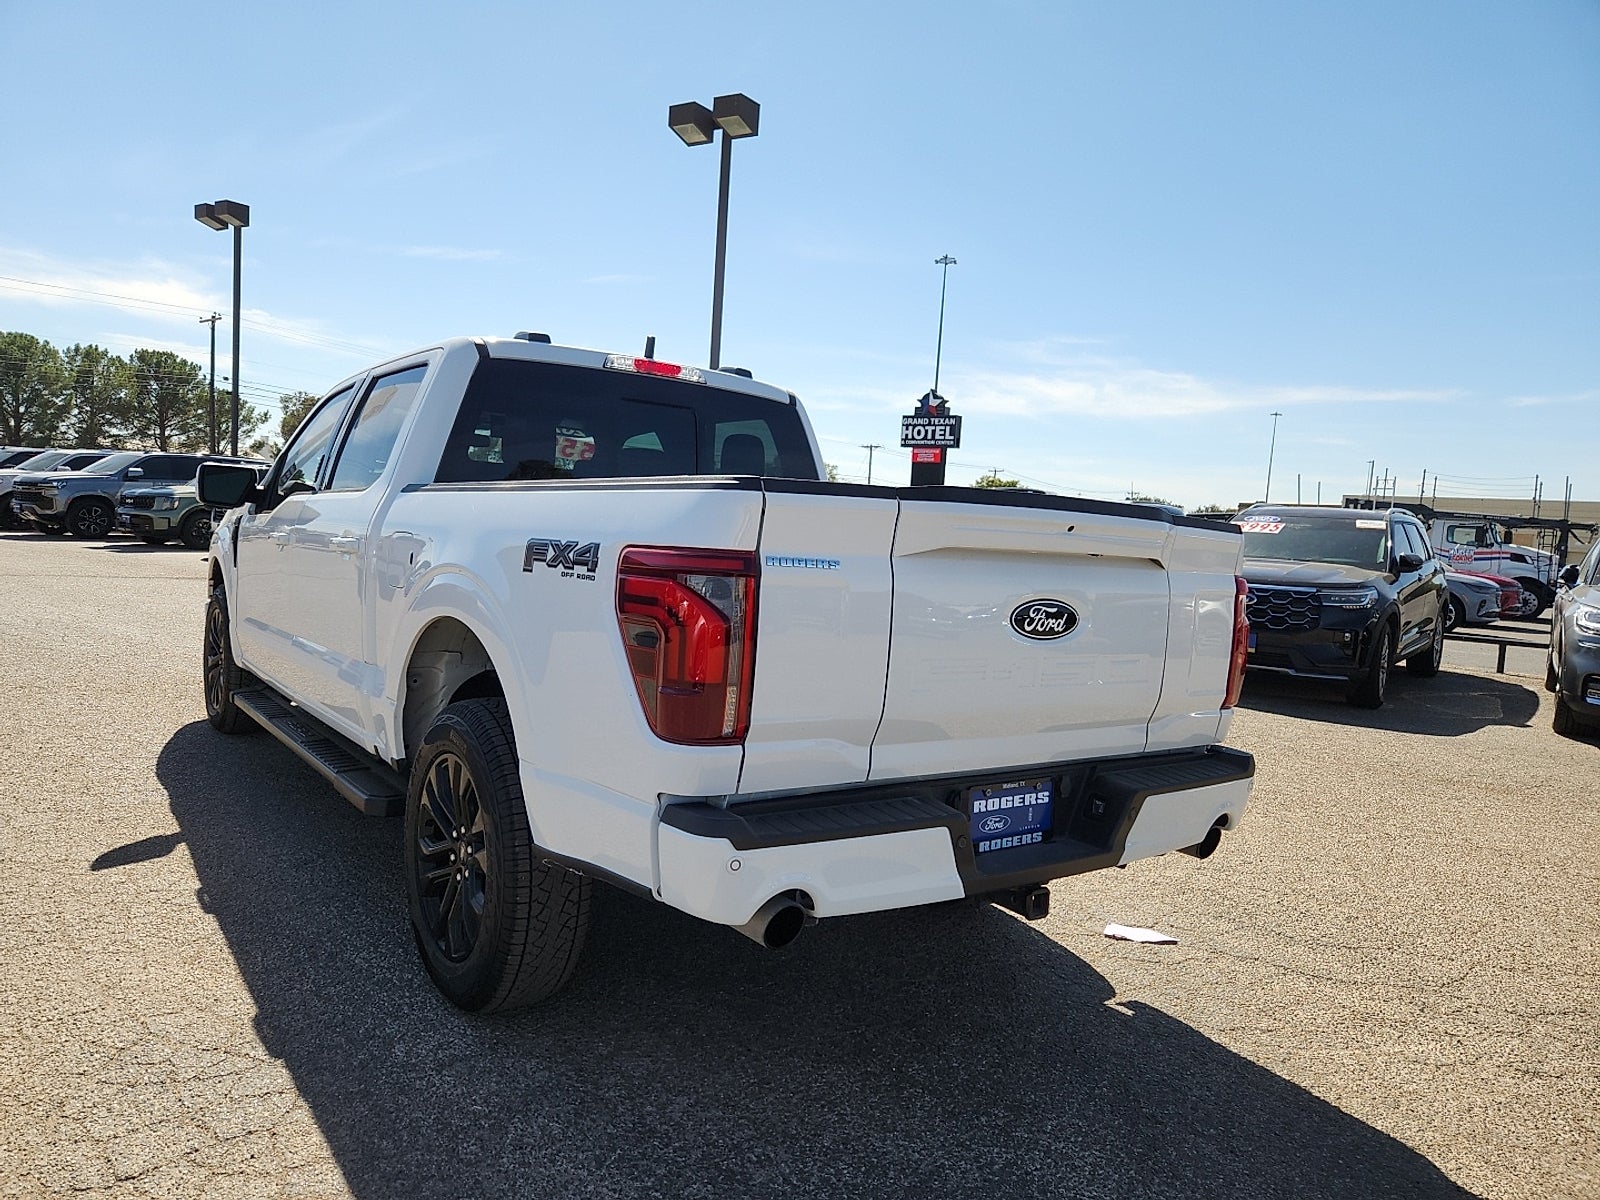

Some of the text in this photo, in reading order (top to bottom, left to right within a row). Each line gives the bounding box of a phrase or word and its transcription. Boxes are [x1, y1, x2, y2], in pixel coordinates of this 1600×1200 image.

[902, 417, 928, 425] GRAND
[901, 425, 954, 440] HOTEL
[522, 538, 601, 573] FX4
[765, 555, 841, 570] ROGERS
[576, 573, 596, 581] ROAD
[1024, 605, 1068, 632] Ford
[973, 791, 1050, 814] ROGERS
[985, 817, 1006, 831] Ford
[979, 831, 1043, 853] ROGERS
